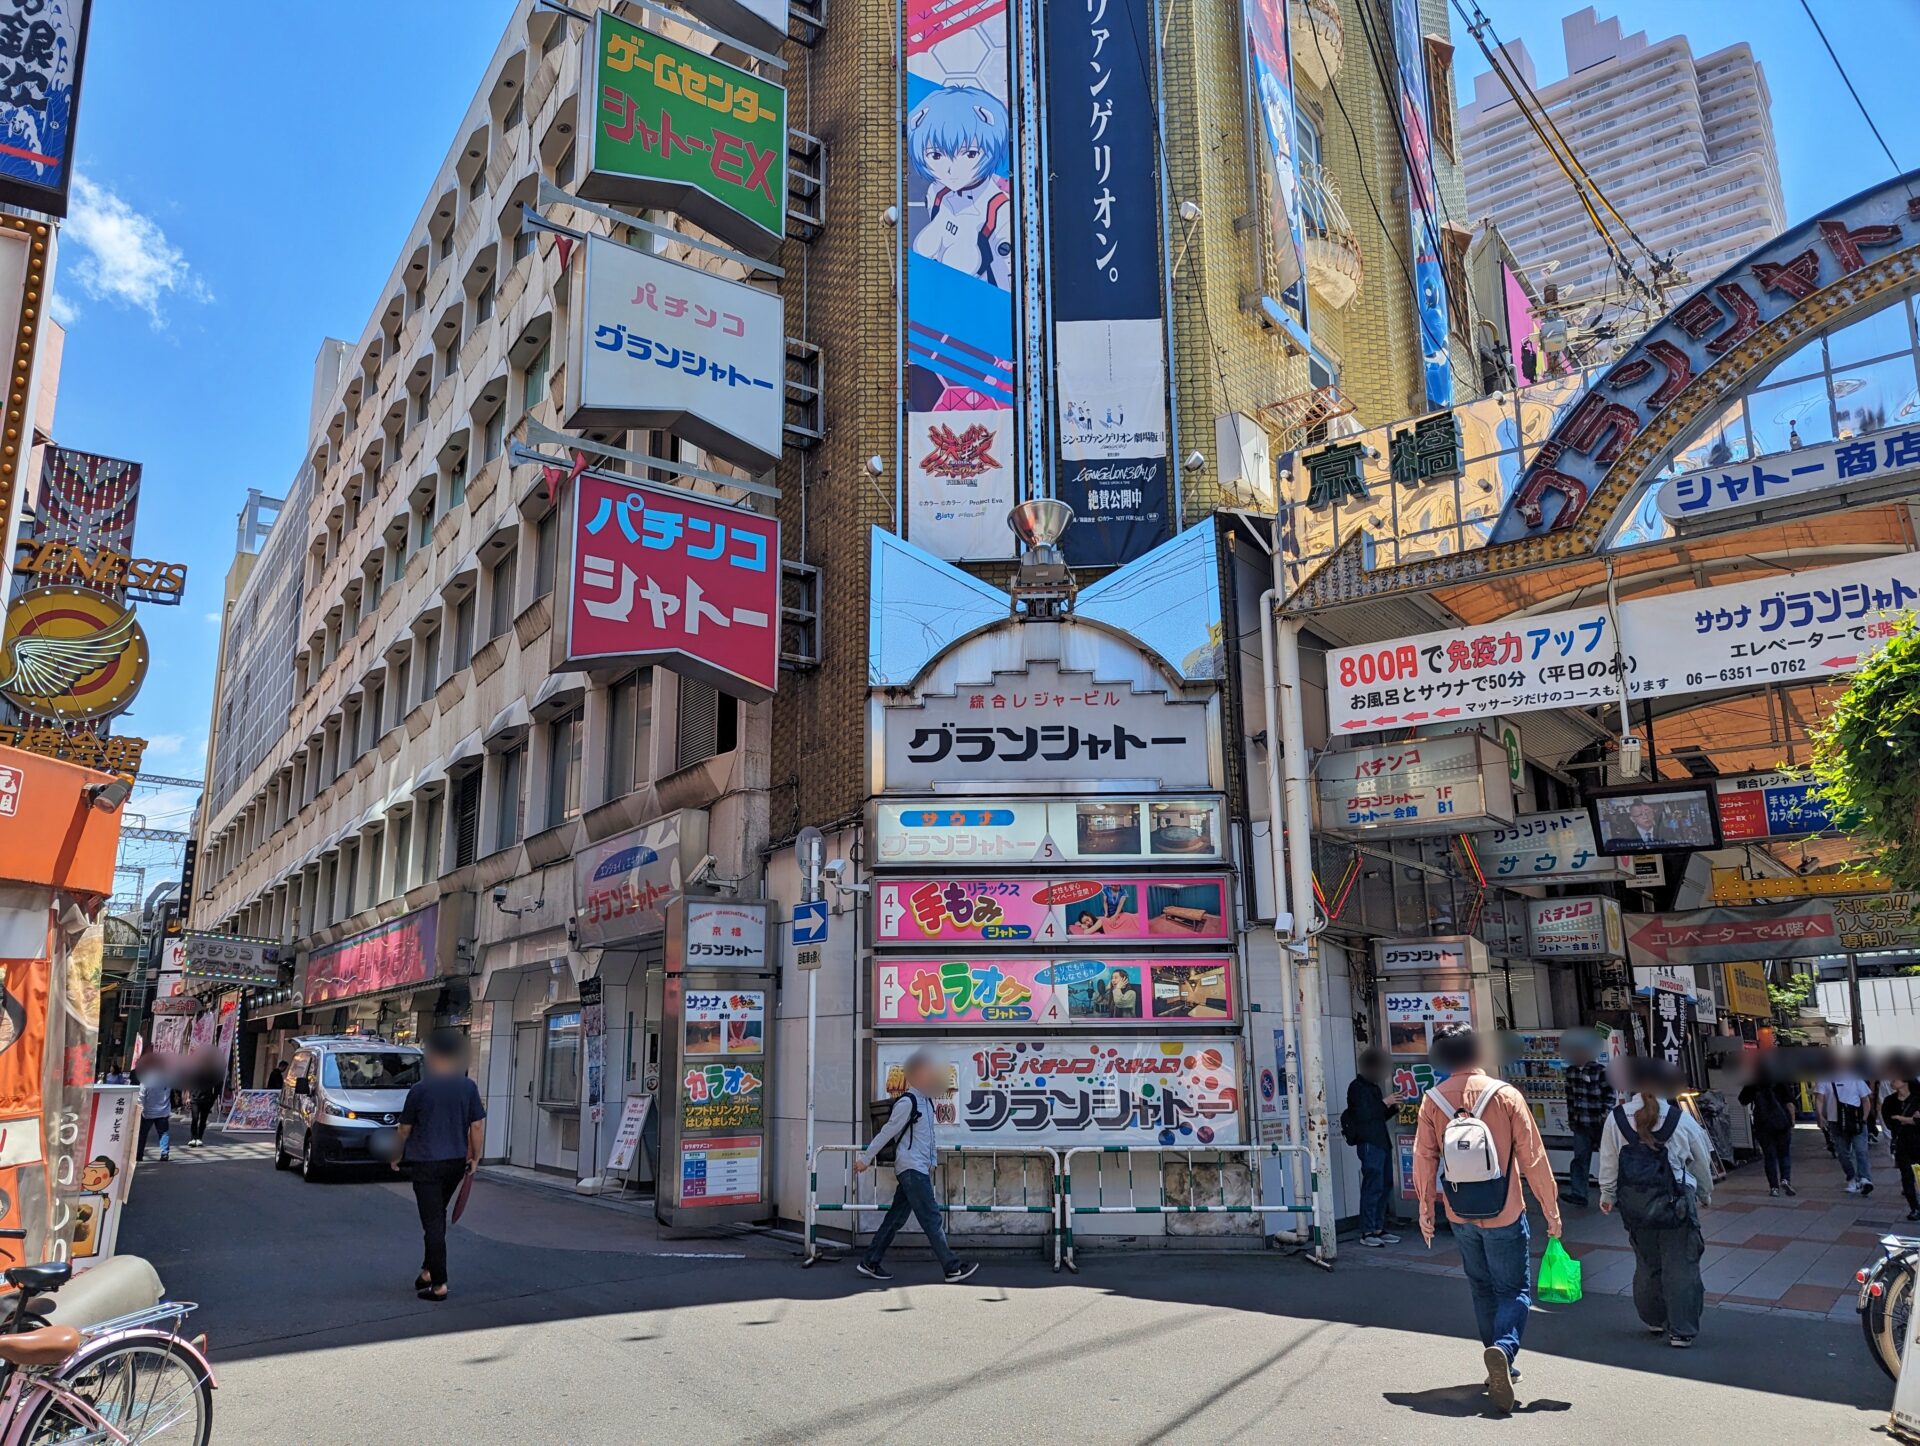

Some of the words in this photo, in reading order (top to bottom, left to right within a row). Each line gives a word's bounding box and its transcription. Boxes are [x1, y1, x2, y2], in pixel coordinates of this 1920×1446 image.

[0, 0, 56, 112] 銀次
[607, 33, 776, 124] ゲームセンター
[631, 282, 745, 338] パチンコ
[594, 323, 774, 390] グランシャトー
[1302, 411, 1463, 511] 京橋
[1087, 488, 1142, 510] 絶賛公開中
[585, 492, 767, 573] パチンコ
[582, 554, 769, 636] シャトー
[1695, 604, 1752, 634] サウナ
[1760, 577, 1920, 633] グランシャト
[969, 691, 1121, 711] 綜合レジャービル
[907, 722, 1187, 764] グランシャトー
[1355, 749, 1421, 780] パチンコ
[1347, 793, 1425, 809] グランシャトー
[1437, 786, 1453, 799] 1F
[1438, 800, 1454, 814] B1
[920, 811, 996, 827] サウナ
[881, 830, 1036, 858] グランシャトー
[1044, 843, 1054, 858] 5
[1498, 851, 1596, 875] サウナ
[968, 882, 1021, 897] リラックス
[911, 882, 1003, 935] 手もみ
[1538, 901, 1593, 925] パチンコ
[712, 927, 742, 937] 京橋
[987, 925, 1031, 939] シャトー
[1044, 923, 1055, 938] 4
[1650, 913, 1825, 947] エレベーターで4階へ
[688, 943, 763, 957] グランシャトー
[1386, 950, 1463, 964] グランシャトー
[686, 995, 721, 1009] サウナ
[910, 962, 1031, 1018] カラオケ
[987, 1006, 1031, 1020] シャトー
[1048, 1004, 1058, 1020] 4
[1387, 996, 1423, 1011] サウナ
[973, 1051, 1015, 1081] 1F
[1018, 1057, 1096, 1074] パチンコ
[1104, 1057, 1182, 1074] パチスロ
[685, 1064, 762, 1100] カラオケ
[686, 1106, 759, 1117] ソフトドリンクバー
[964, 1084, 1235, 1132] グランシャトー
